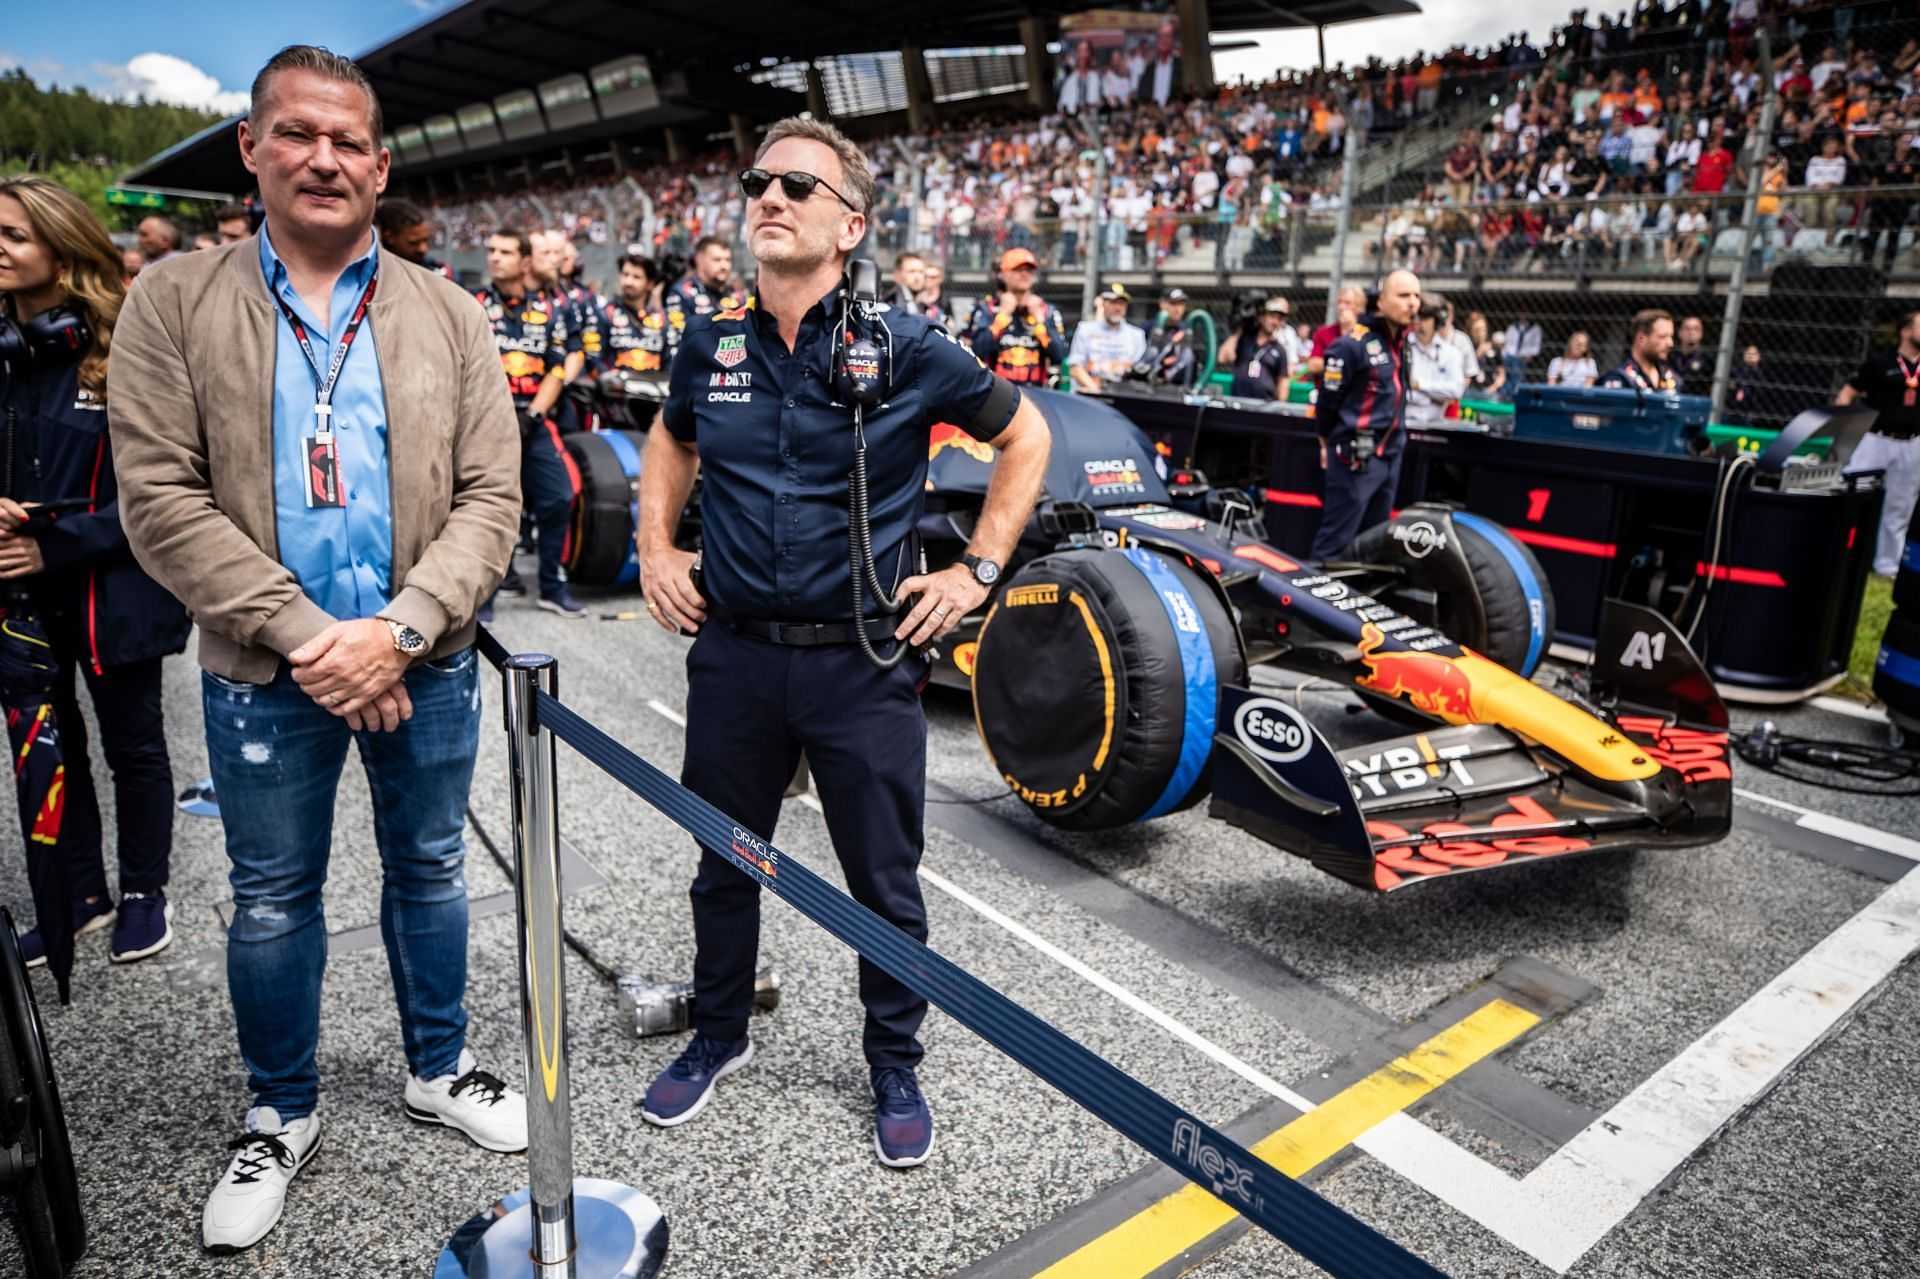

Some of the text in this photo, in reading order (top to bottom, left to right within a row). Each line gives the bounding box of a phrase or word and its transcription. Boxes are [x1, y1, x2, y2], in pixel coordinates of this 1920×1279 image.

[719, 336, 745, 350] TAG
[707, 392, 752, 403] ORACLE
[1526, 488, 1551, 522] 1
[1006, 583, 1059, 608] PIRELLI
[1619, 631, 1666, 670] A1
[1005, 774, 1068, 807] ZERO
[732, 826, 778, 865] ORACLE
